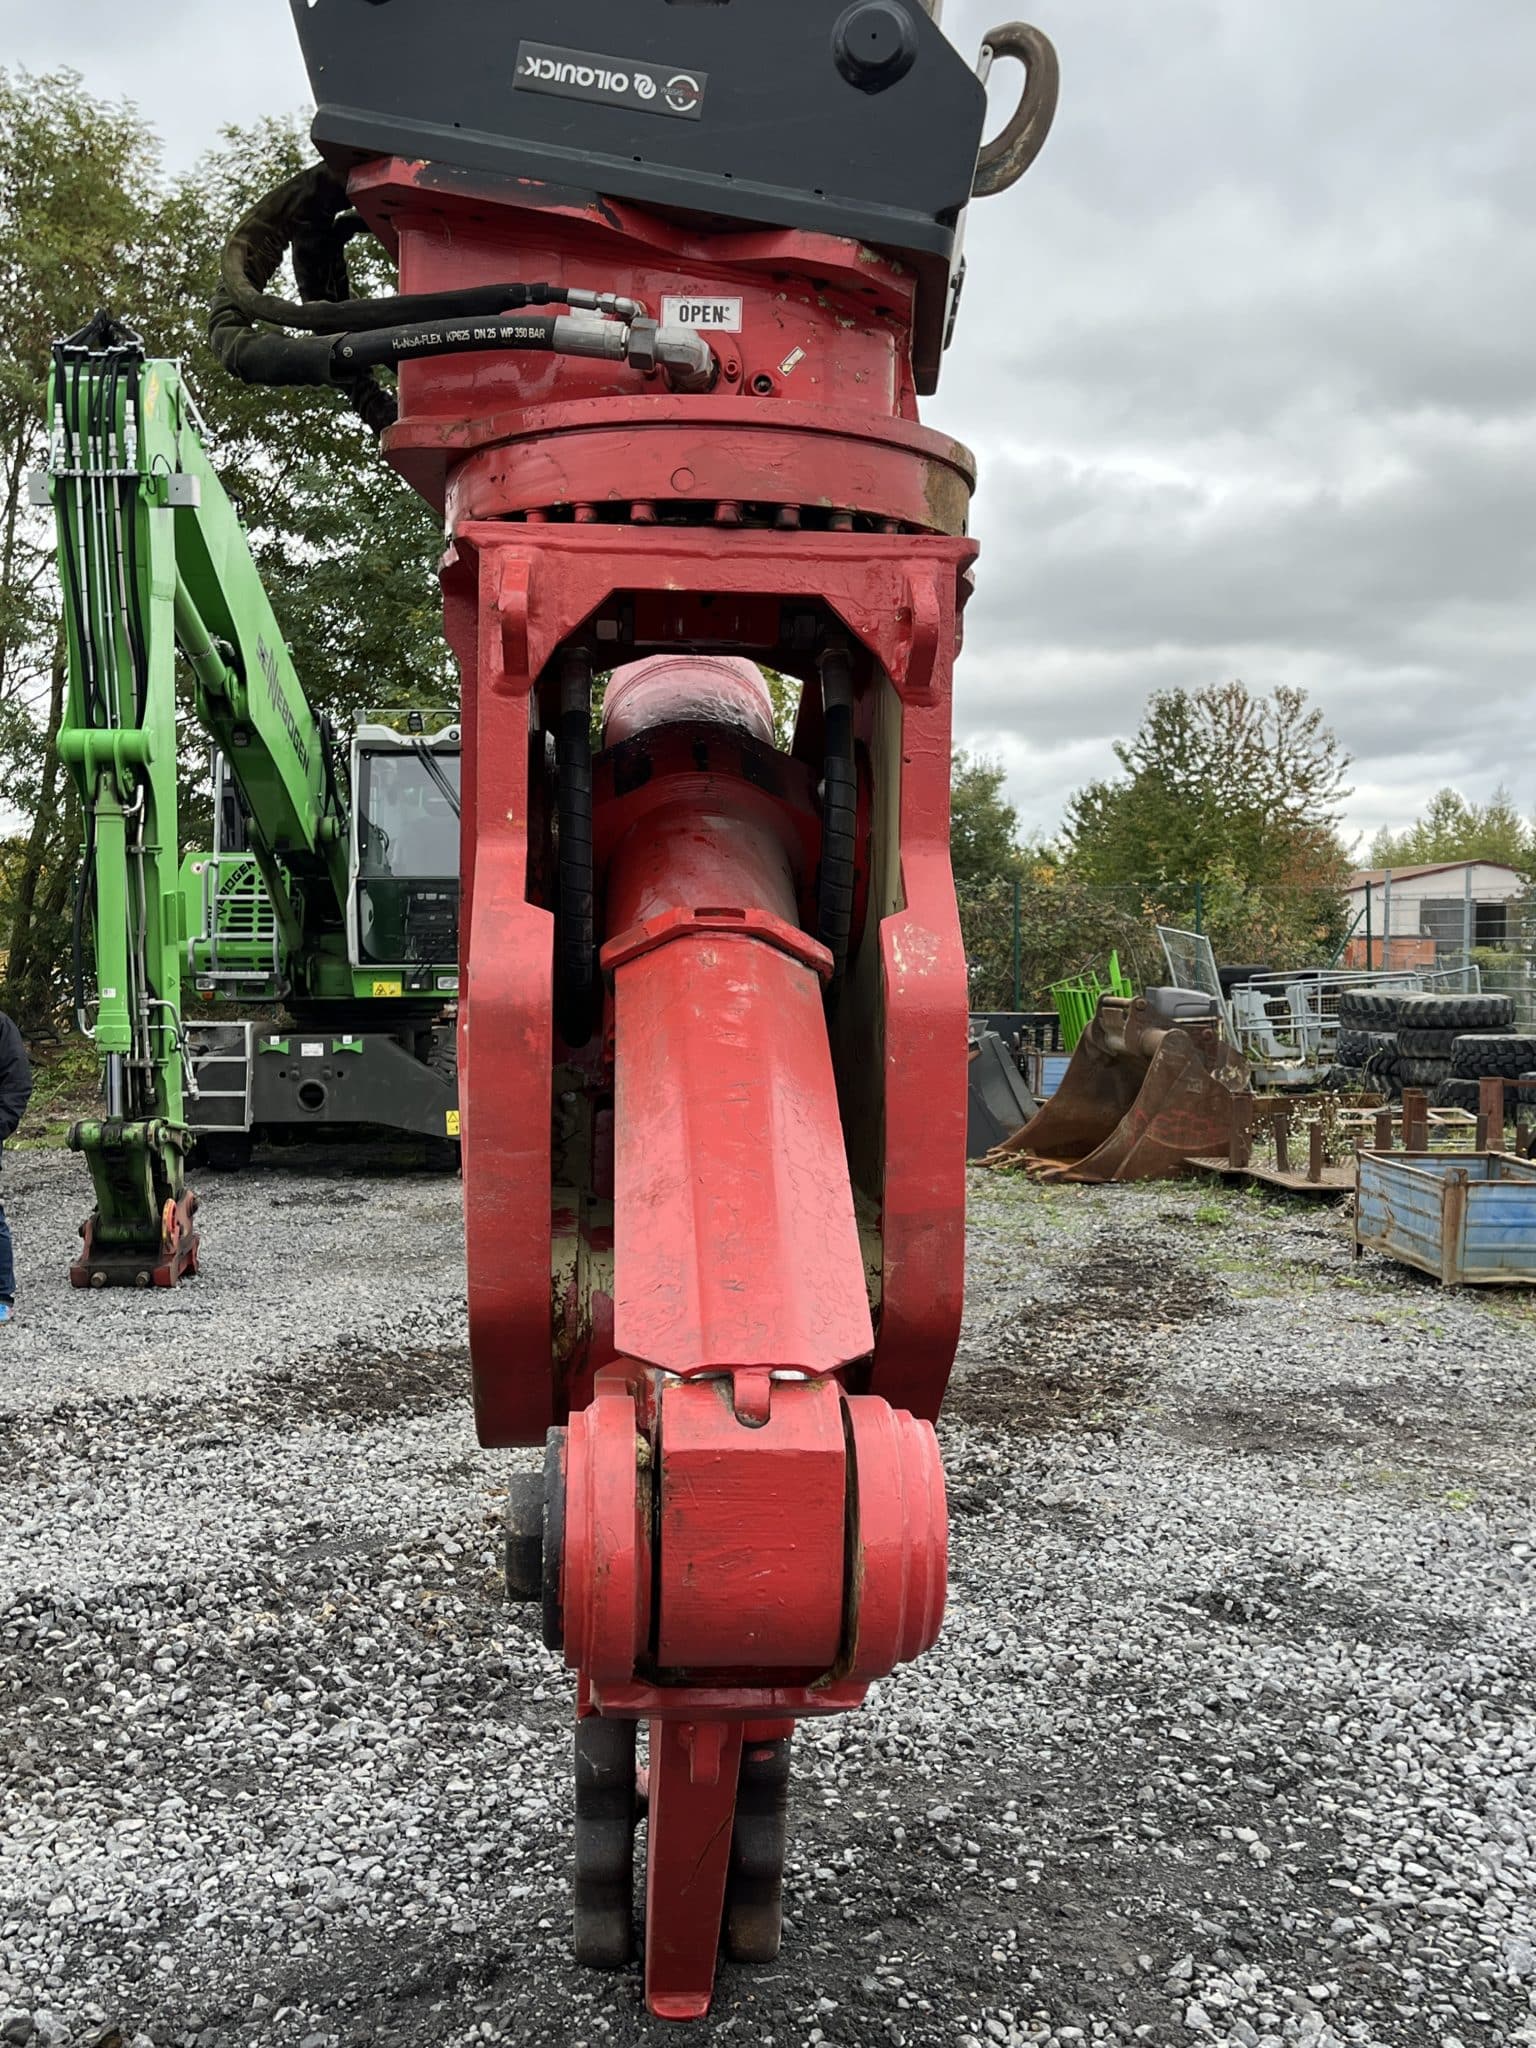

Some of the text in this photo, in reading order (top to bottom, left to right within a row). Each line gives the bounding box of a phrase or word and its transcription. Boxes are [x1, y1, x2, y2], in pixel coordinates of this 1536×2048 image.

[525, 56, 629, 92] OILQUICK
[679, 304, 724, 323] OPEN
[446, 329, 470, 342] KP625
[474, 328, 486, 340] DN
[487, 328, 497, 339] 25
[500, 327, 514, 338] WP
[515, 328, 528, 338] 350
[528, 328, 545, 339] BAR
